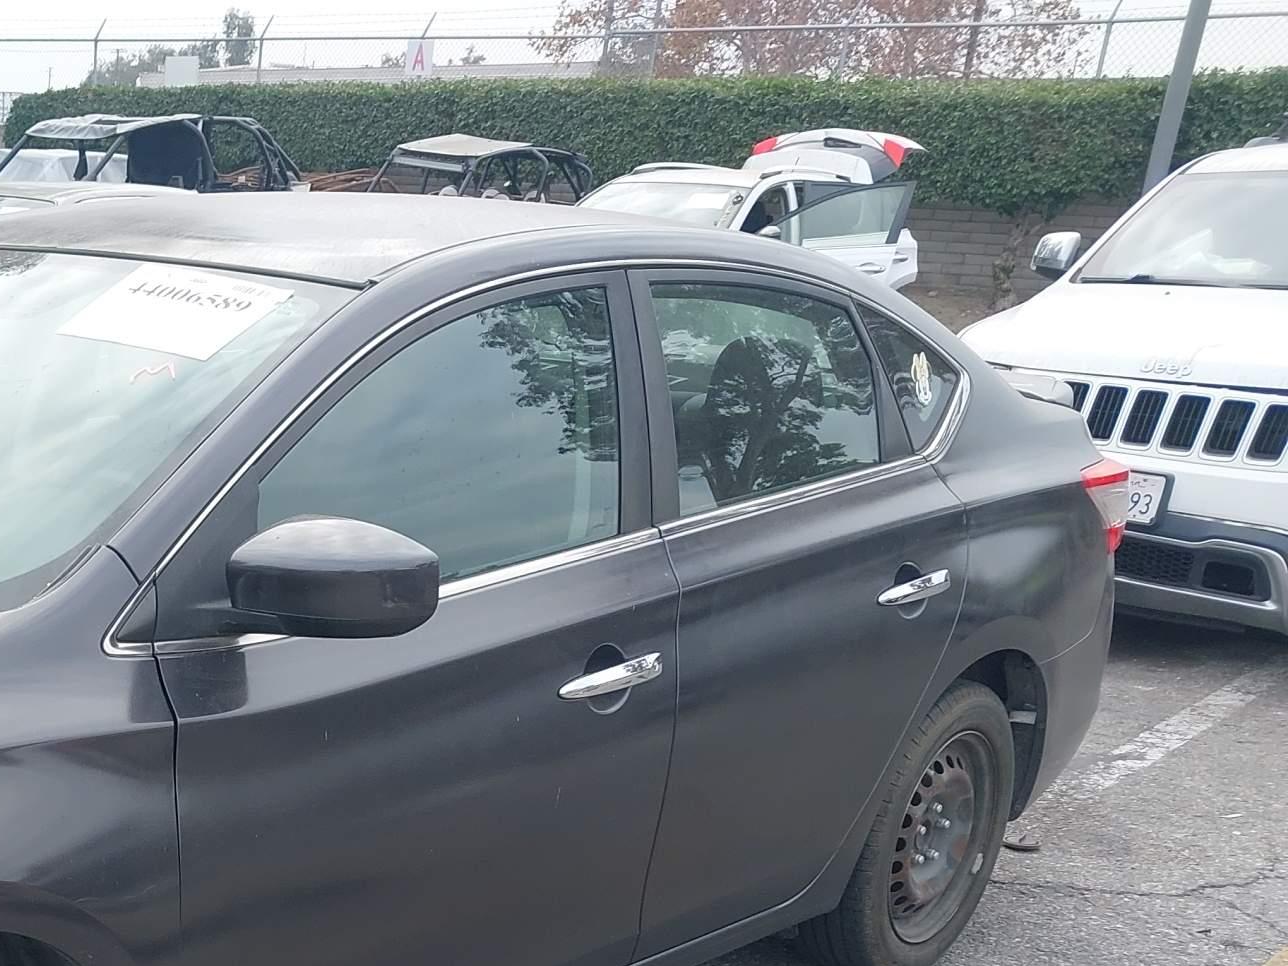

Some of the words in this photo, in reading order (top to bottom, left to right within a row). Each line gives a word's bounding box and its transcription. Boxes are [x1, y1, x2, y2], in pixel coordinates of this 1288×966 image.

[128, 281, 253, 312] 44006589
[1139, 355, 1193, 379] Jeep
[1127, 492, 1152, 515] 93
